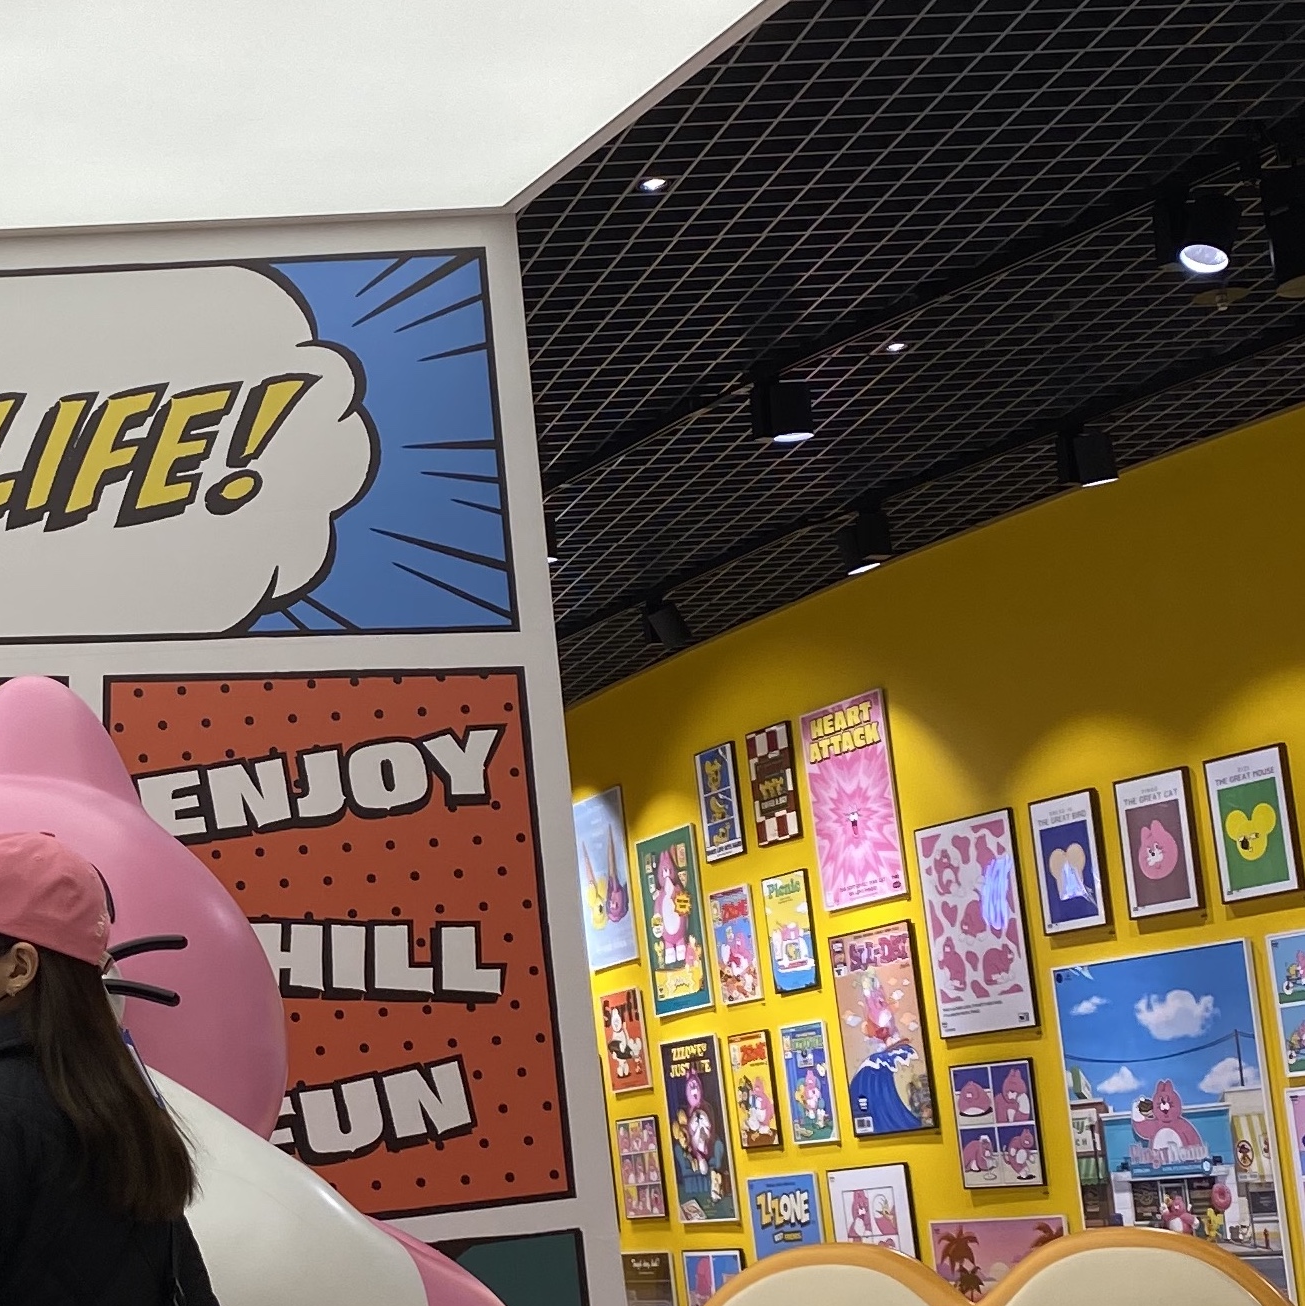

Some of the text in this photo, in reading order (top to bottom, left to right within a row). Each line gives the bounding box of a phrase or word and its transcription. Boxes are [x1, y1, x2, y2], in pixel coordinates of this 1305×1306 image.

[810, 700, 872, 741] HEART
[810, 721, 881, 764] ATTACK
[130, 723, 507, 846] ENJOY
[1123, 788, 1178, 806] THE GREAT CAT
[1229, 772, 1250, 783] GREAT
[247, 916, 507, 1004] HILL
